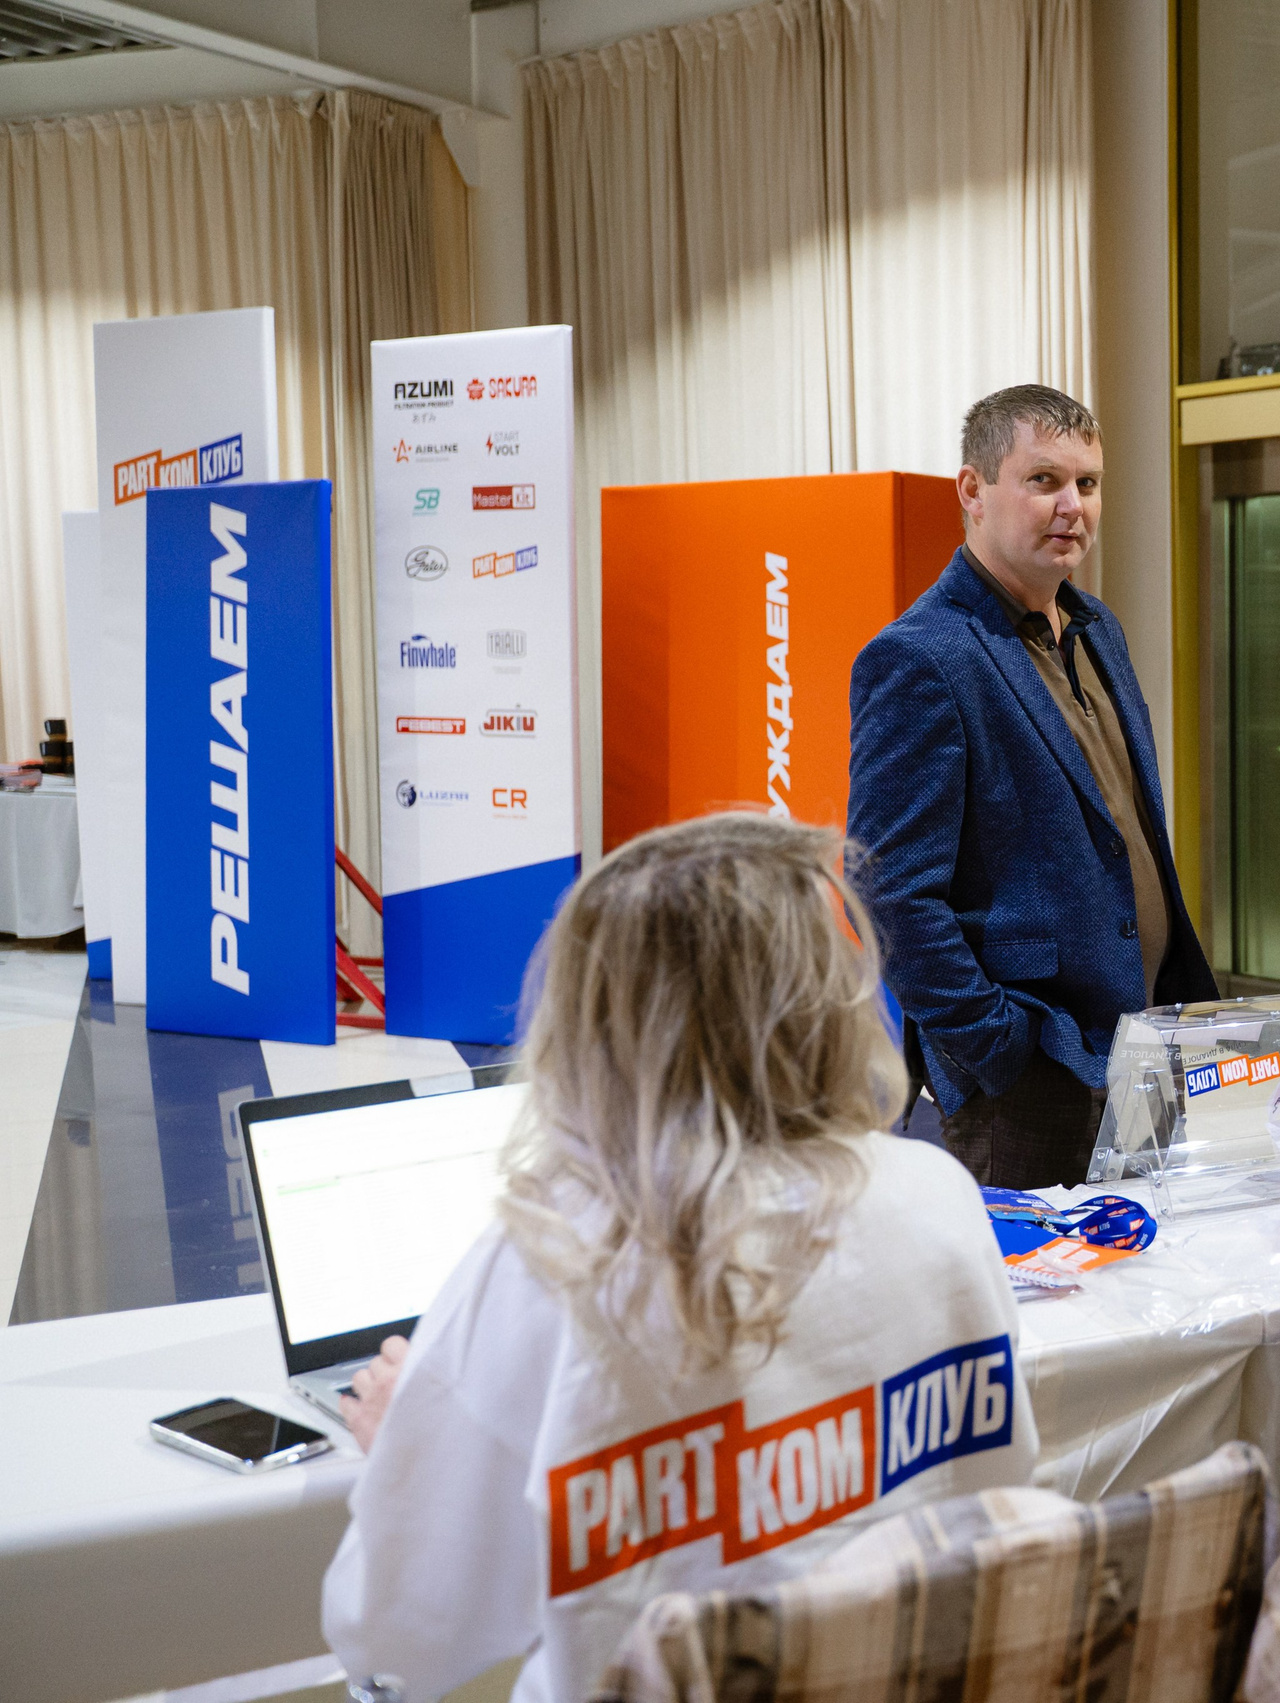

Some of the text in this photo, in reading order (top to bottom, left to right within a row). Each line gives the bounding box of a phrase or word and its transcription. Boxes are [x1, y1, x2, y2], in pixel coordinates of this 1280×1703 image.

[394, 380, 454, 399] AZUMI
[489, 376, 537, 398] SAKURA
[416, 444, 459, 454] AIRLINE
[494, 444, 519, 456] VOLT
[117, 455, 157, 500] PART
[202, 440, 241, 482] КЛУБ
[400, 641, 456, 668] Finwhale
[765, 551, 793, 820] УЖДАЕМ
[209, 501, 250, 996] РЕШАЕМ
[492, 788, 527, 808] CR
[1187, 1068, 1218, 1093] КЛУБ
[1250, 1056, 1280, 1082] PART
[565, 1421, 725, 1573] PART
[887, 1351, 1006, 1477] КЛУБ
